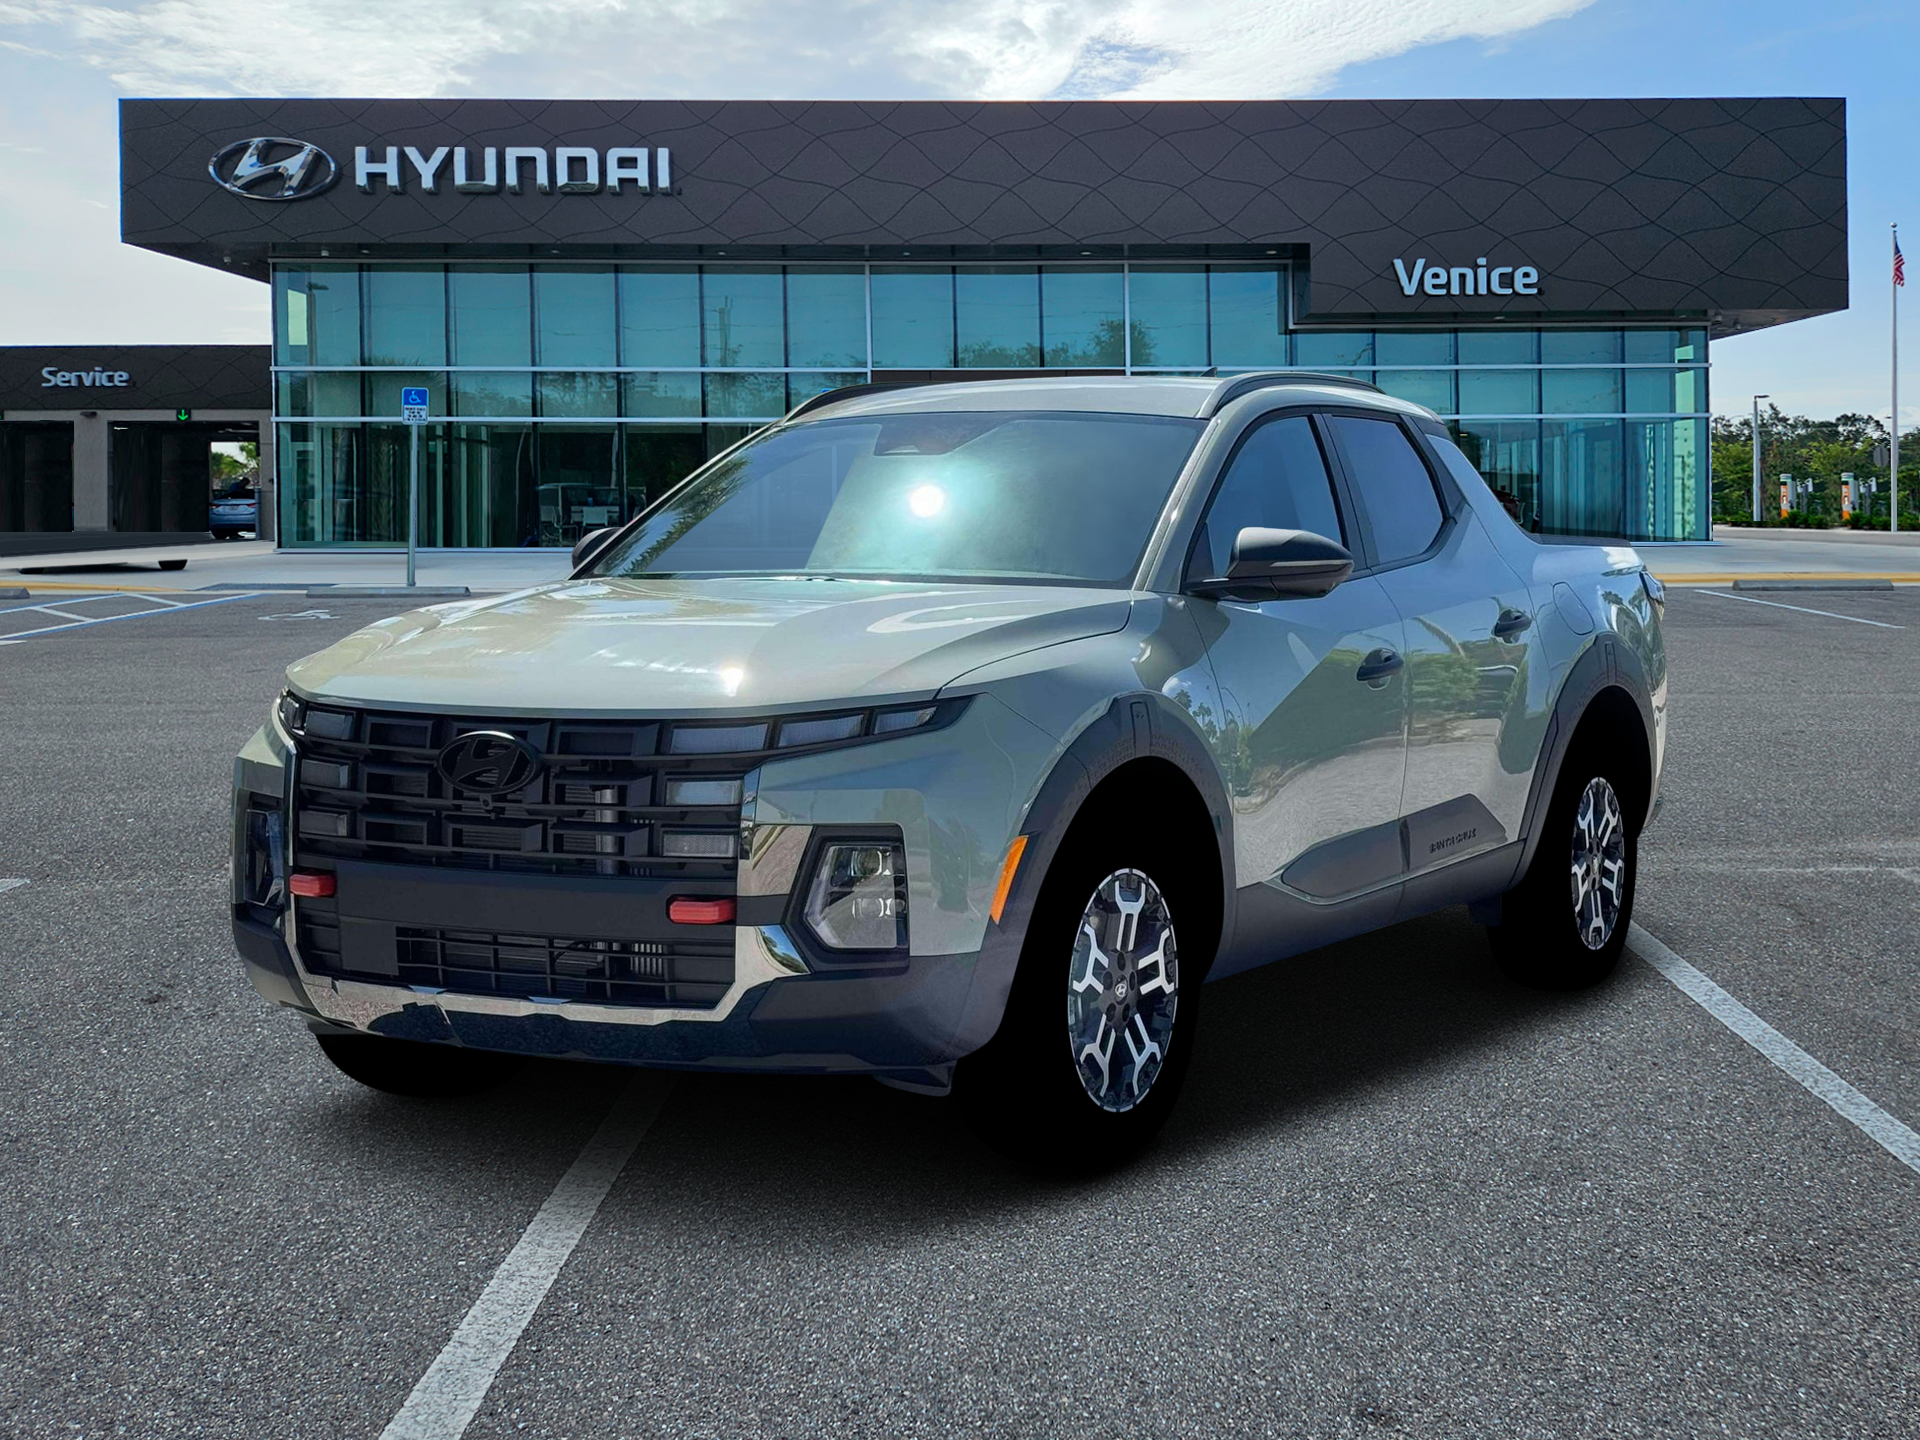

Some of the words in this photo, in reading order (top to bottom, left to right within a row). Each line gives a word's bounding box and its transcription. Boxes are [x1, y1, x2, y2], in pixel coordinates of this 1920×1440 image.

[354, 146, 671, 193] HYUNDAI
[1393, 257, 1539, 296] Venice
[41, 366, 130, 387] Service
